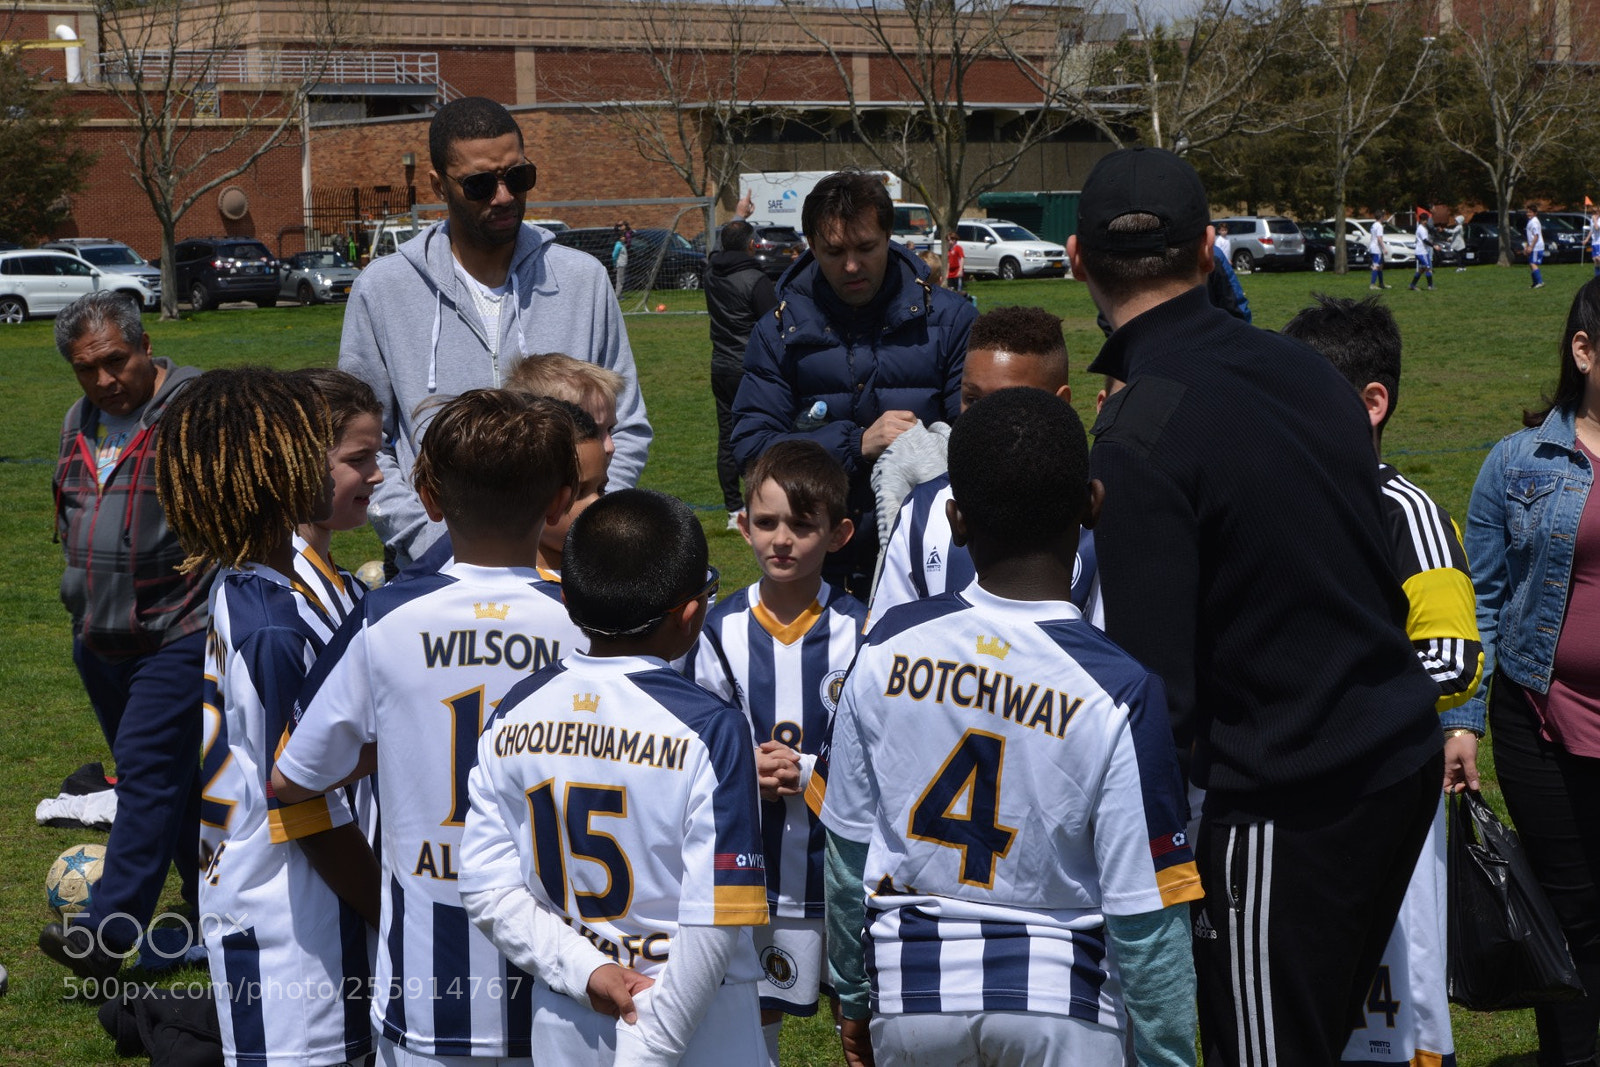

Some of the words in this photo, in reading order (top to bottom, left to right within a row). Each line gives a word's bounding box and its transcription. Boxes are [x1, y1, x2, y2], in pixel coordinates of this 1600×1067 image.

[768, 199, 783, 209] SAFE
[419, 630, 560, 673] WILSON
[884, 654, 1085, 740] BOTCHWAY
[494, 721, 690, 771] CHOQUEHUAMANI
[906, 727, 1019, 891] 4
[411, 841, 461, 881] AL
[525, 777, 635, 923] 15
